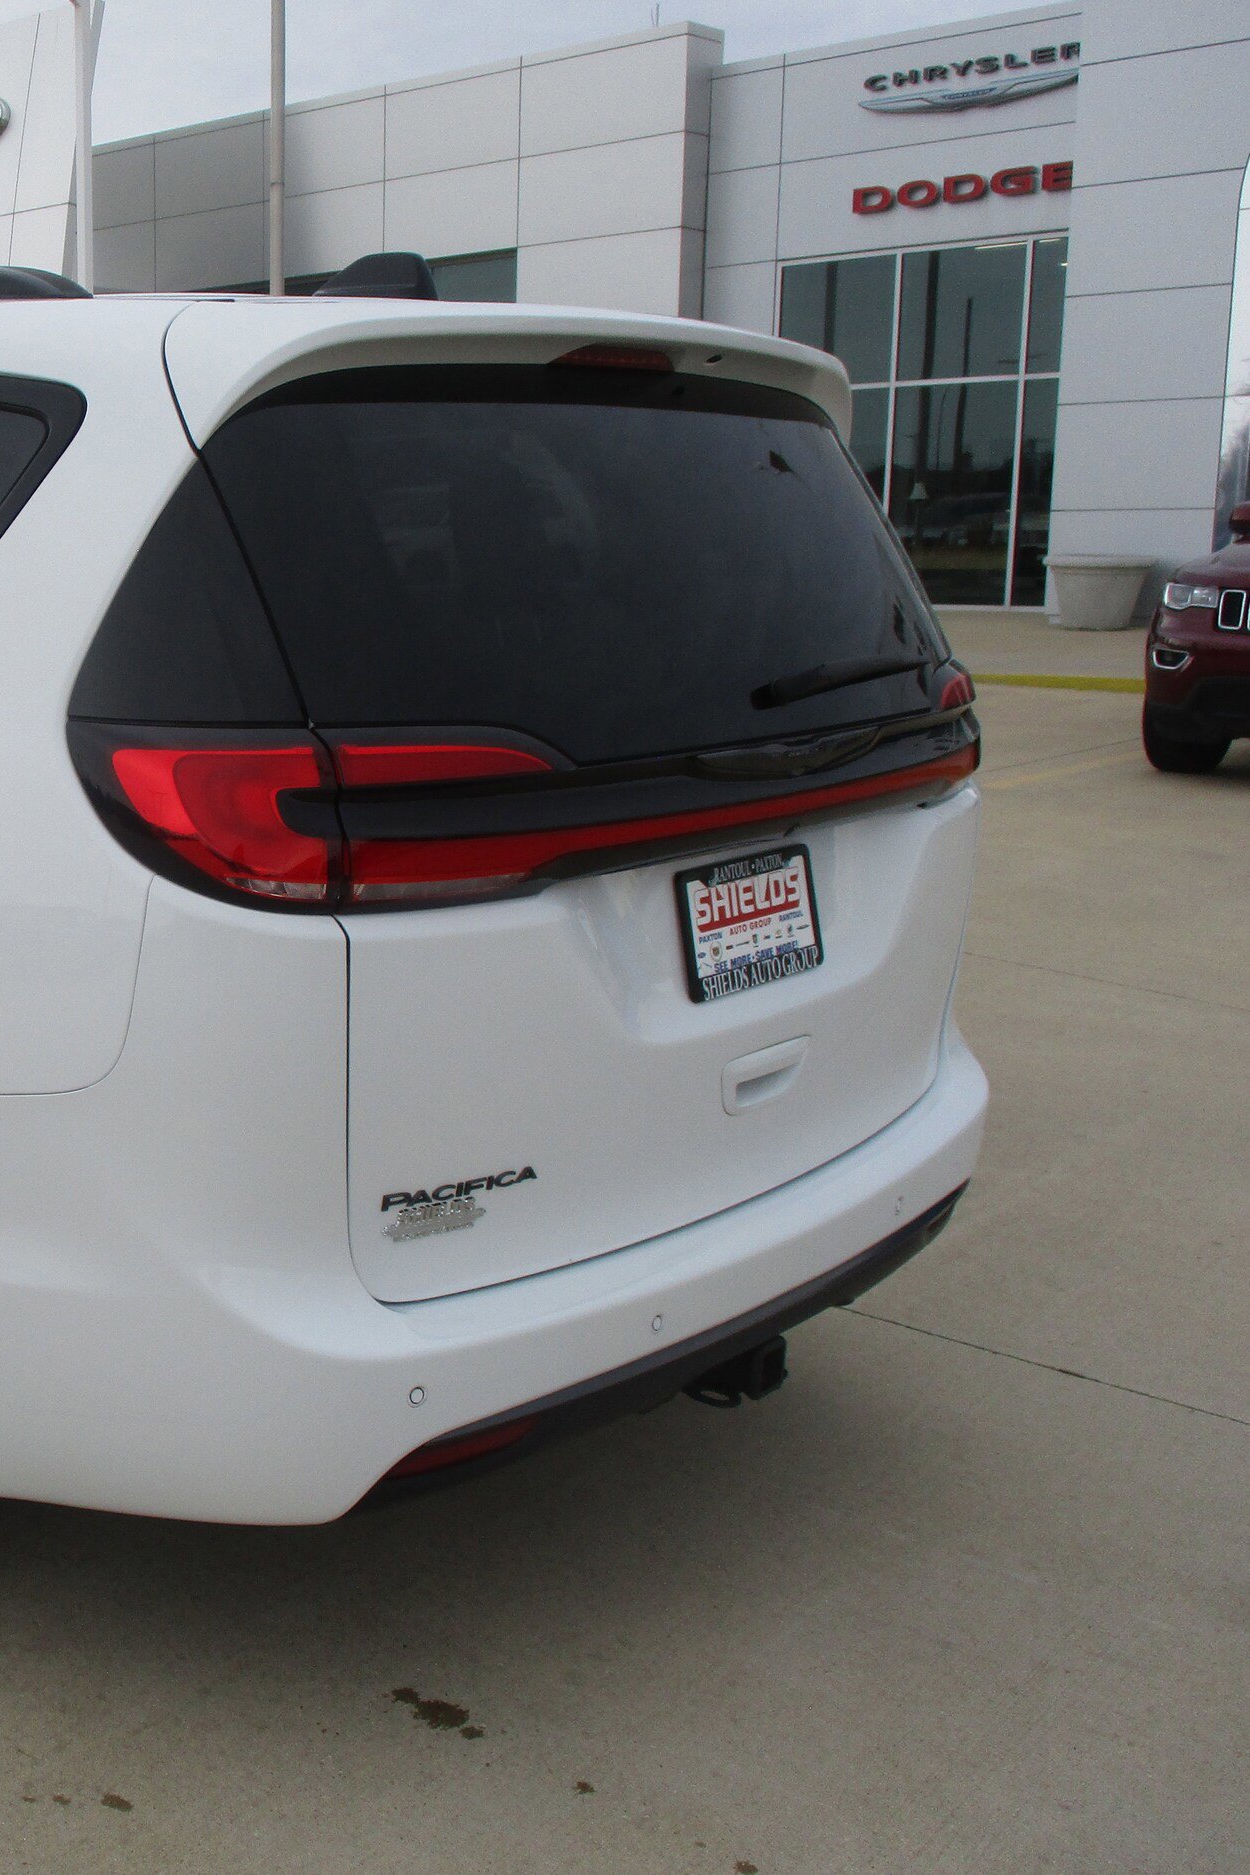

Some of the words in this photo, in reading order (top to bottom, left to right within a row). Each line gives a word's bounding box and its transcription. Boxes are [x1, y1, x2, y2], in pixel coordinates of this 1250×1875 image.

[863, 41, 1080, 92] CHRYSLER
[852, 160, 1074, 216] DODGE
[694, 867, 801, 926] SHIELDS
[699, 931, 723, 944] PAXTON
[729, 924, 748, 936] AUTO
[750, 917, 772, 930] GROUP
[702, 966, 750, 1001] SHIELDS
[751, 955, 781, 987] AUTO
[782, 945, 819, 975] GROUP
[714, 960, 729, 973] SEE
[730, 953, 751, 968] MORE
[755, 947, 774, 960] SAVE
[381, 1166, 538, 1212] PACIFICA
